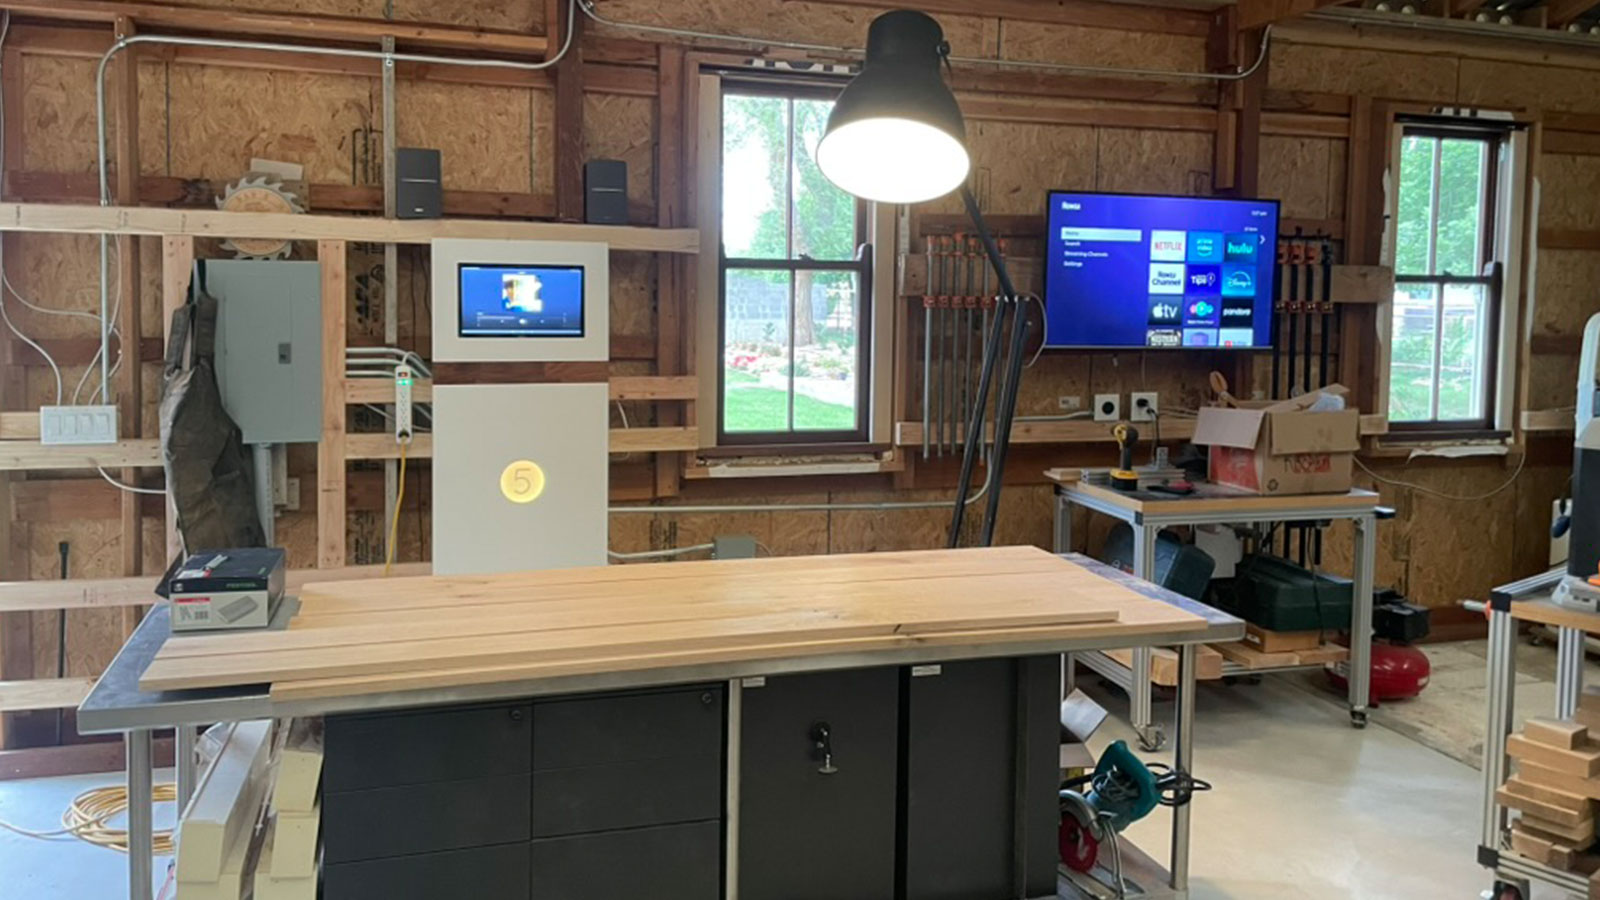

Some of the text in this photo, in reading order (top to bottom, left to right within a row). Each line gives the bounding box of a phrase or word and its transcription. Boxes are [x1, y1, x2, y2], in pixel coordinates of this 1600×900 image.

[1155, 241, 1182, 251] NETFLIX
[1227, 242, 1253, 254] hulu
[1157, 270, 1176, 278] Roku
[1152, 278, 1181, 286] Channel
[1163, 304, 1178, 318] tv
[1223, 308, 1251, 316] pandora
[513, 467, 531, 495] 5
